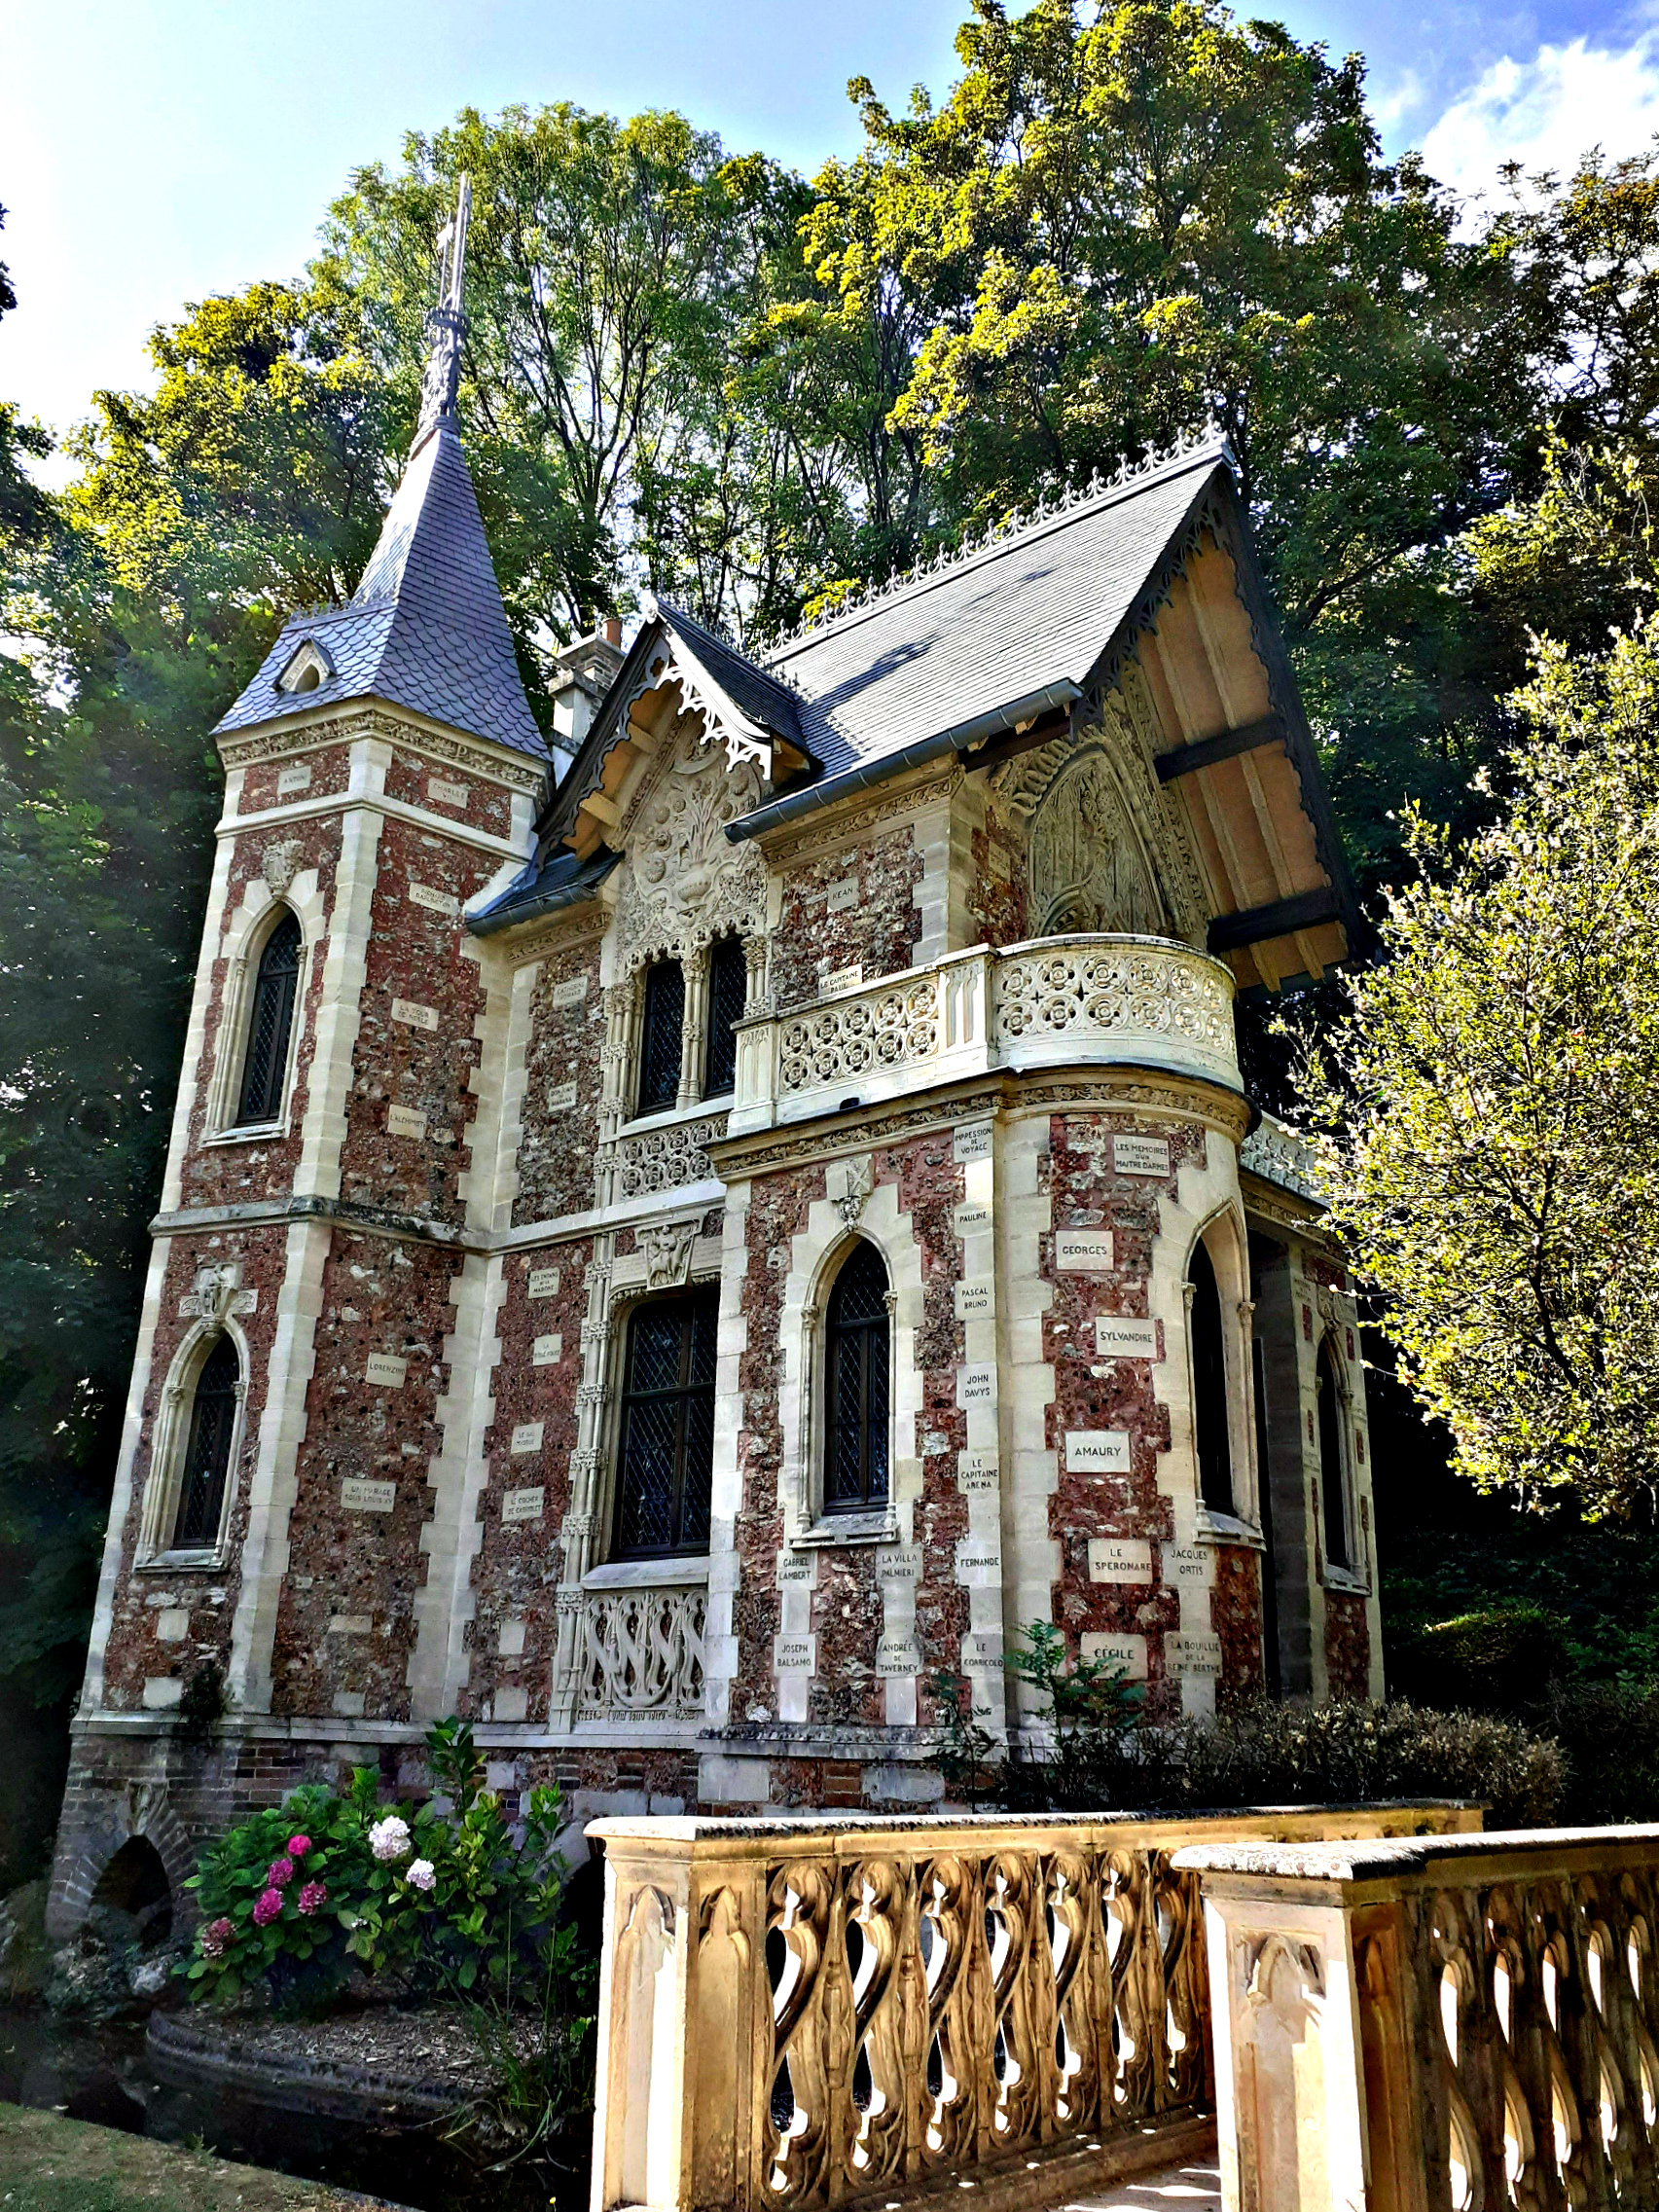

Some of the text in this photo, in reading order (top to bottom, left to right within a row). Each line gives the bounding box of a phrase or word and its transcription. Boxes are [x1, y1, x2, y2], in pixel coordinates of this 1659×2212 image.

[832, 887, 853, 900] KEAN
[820, 970, 859, 990] LE CAPITAINE
[830, 983, 848, 994] PAUL
[400, 1004, 429, 1018] LA TOUR
[961, 1142, 988, 1154] VOYAGE
[959, 1212, 987, 1223] PAULINE
[1062, 1246, 1107, 1255] GEORGES
[961, 1287, 989, 1297] PASCAL
[964, 1299, 988, 1310] BRUNO
[1100, 1331, 1153, 1343] SYLVANDIRE
[967, 1374, 989, 1385] JOHN
[965, 1387, 991, 1398] DAVYS
[1075, 1446, 1121, 1457] AMAURY
[972, 1459, 983, 1468] LE
[960, 1469, 998, 1480] CAPITAINE
[965, 1481, 992, 1490] ARENA
[1110, 1548, 1122, 1557] LE
[1171, 1548, 1208, 1560] JACQUES
[783, 1557, 810, 1567] GABRIEL
[882, 1553, 918, 1564] LA VILLA
[960, 1556, 999, 1568] FERNANDE
[881, 1568, 915, 1577] PALMIERI
[1095, 1562, 1151, 1572] SPERONARE
[1179, 1565, 1204, 1576] ORTIS
[778, 1571, 811, 1580] LAMBERT
[781, 1645, 809, 1653] JOSEPH
[883, 1640, 913, 1652] ANDRÉE
[976, 1643, 987, 1651] LE
[777, 1658, 811, 1667] BALSAMO
[963, 1658, 1003, 1667] CORRICOLO
[880, 1664, 919, 1673] TAVERNEY
